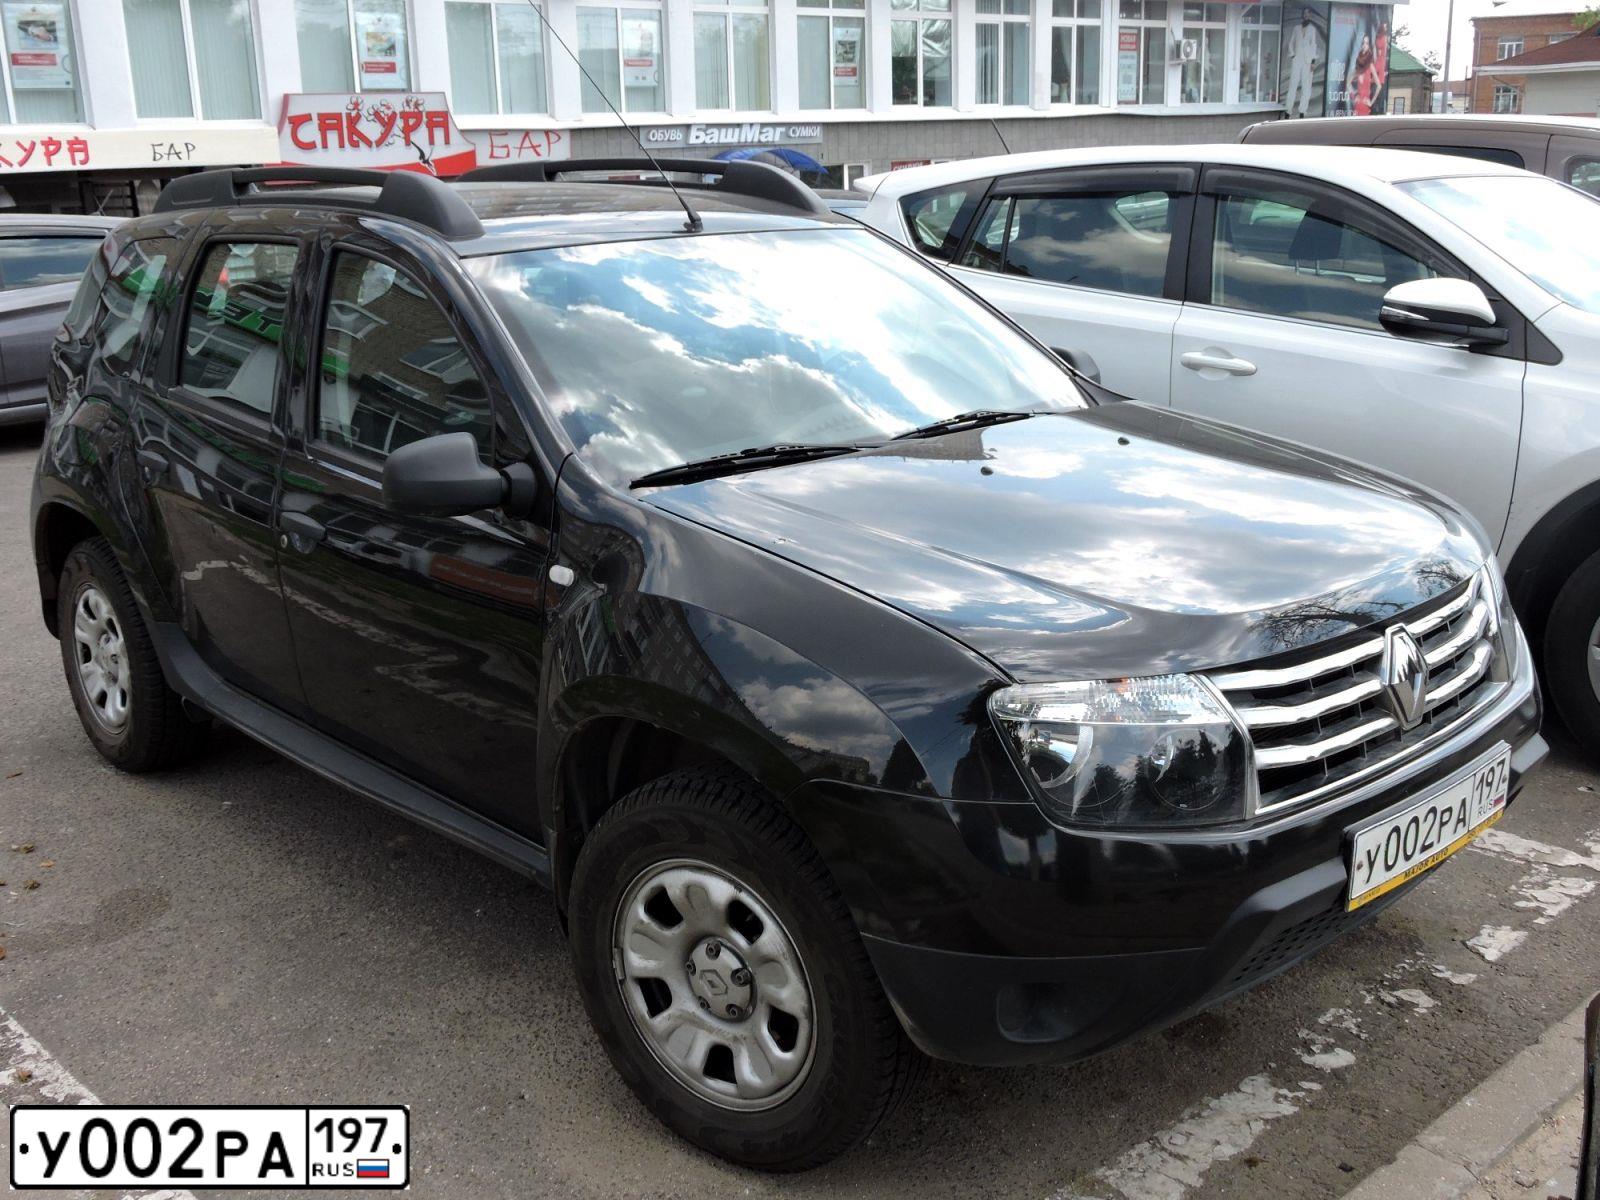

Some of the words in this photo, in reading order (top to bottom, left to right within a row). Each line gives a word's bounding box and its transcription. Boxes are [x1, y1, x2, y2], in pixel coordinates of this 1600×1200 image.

[287, 109, 451, 151] САКУРА
[488, 129, 562, 160] БАР
[648, 129, 683, 142] ОБУВЬ
[689, 123, 786, 144] БашМаг
[788, 126, 821, 138] СУМКИ
[150, 142, 196, 162] БАР
[1475, 759, 1505, 804] 197
[1477, 799, 1494, 817] RUS
[1403, 859, 1430, 881] MAJOR
[1430, 847, 1449, 864] AUTO
